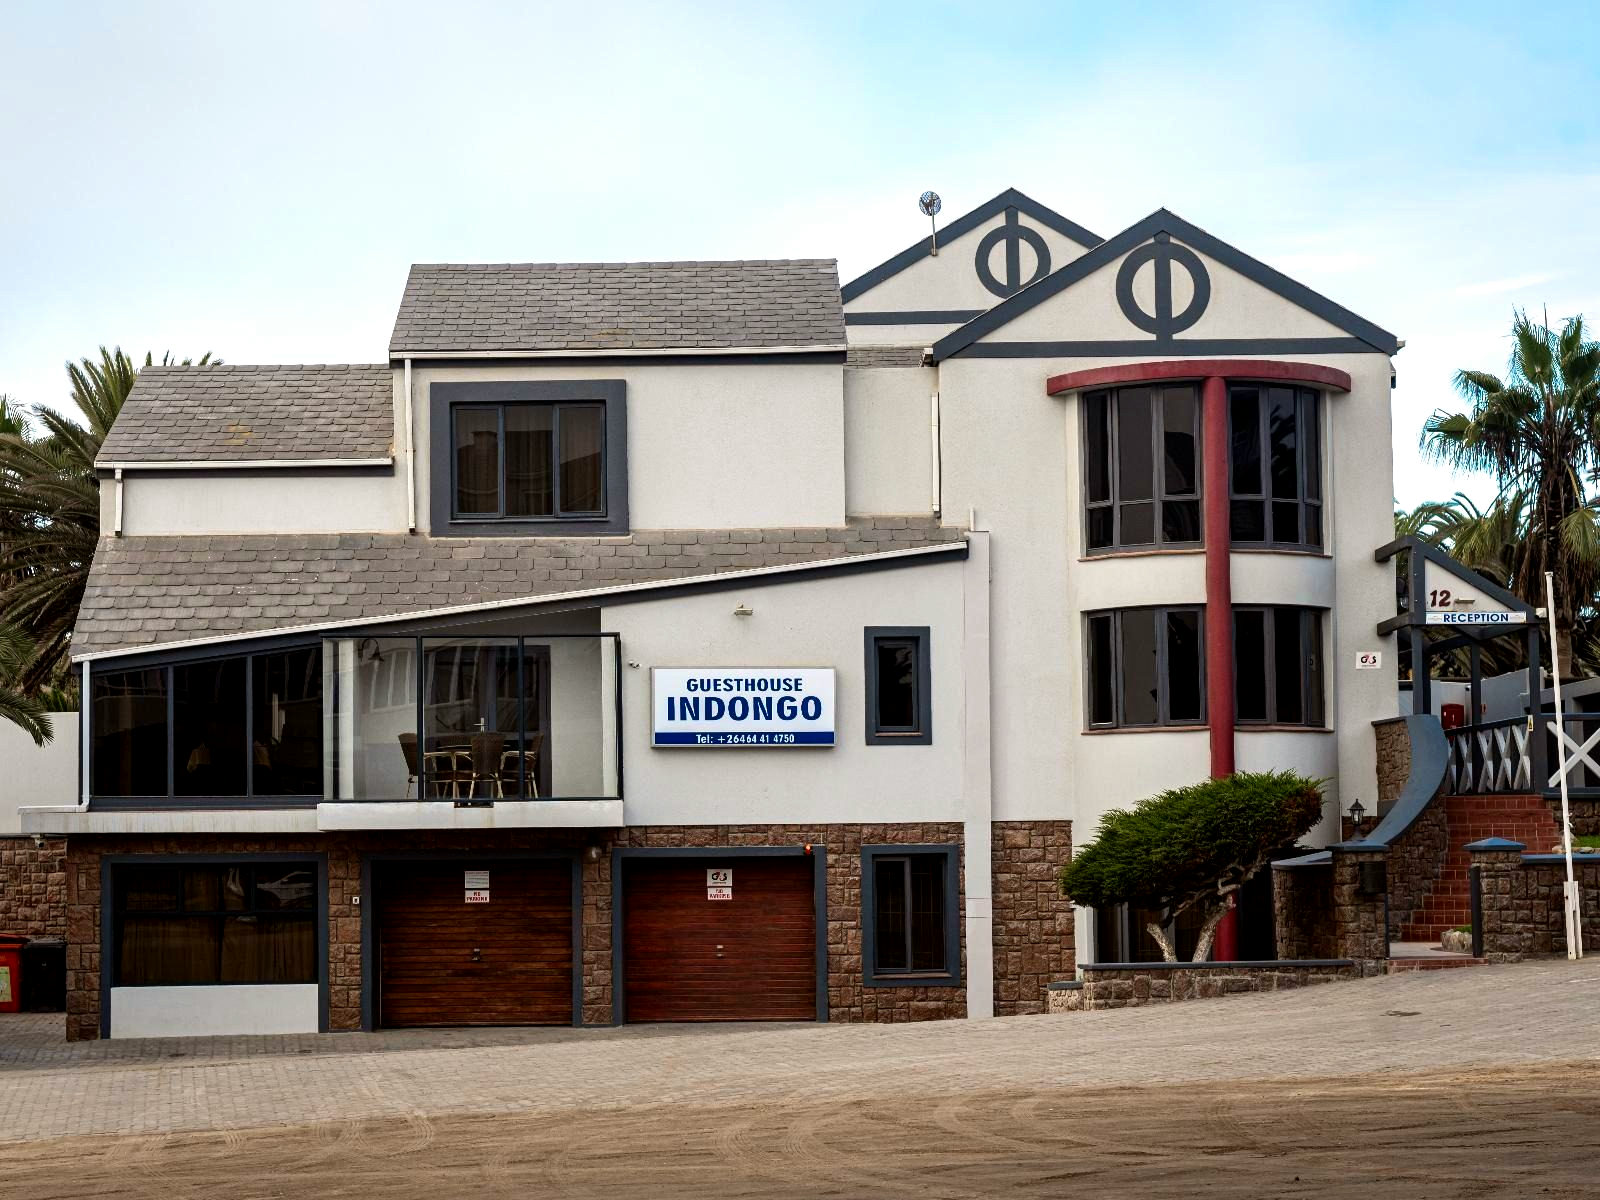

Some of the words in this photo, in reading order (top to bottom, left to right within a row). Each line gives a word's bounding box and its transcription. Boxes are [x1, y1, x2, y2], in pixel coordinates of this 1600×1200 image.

[1429, 589, 1451, 608] 12
[1443, 613, 1509, 623] RECEPTION
[686, 678, 803, 692] GUESTHOUSE
[667, 695, 822, 721] INDONGO
[696, 734, 714, 744] Tel:
[759, 734, 770, 744] 41
[773, 734, 795, 744] 4750
